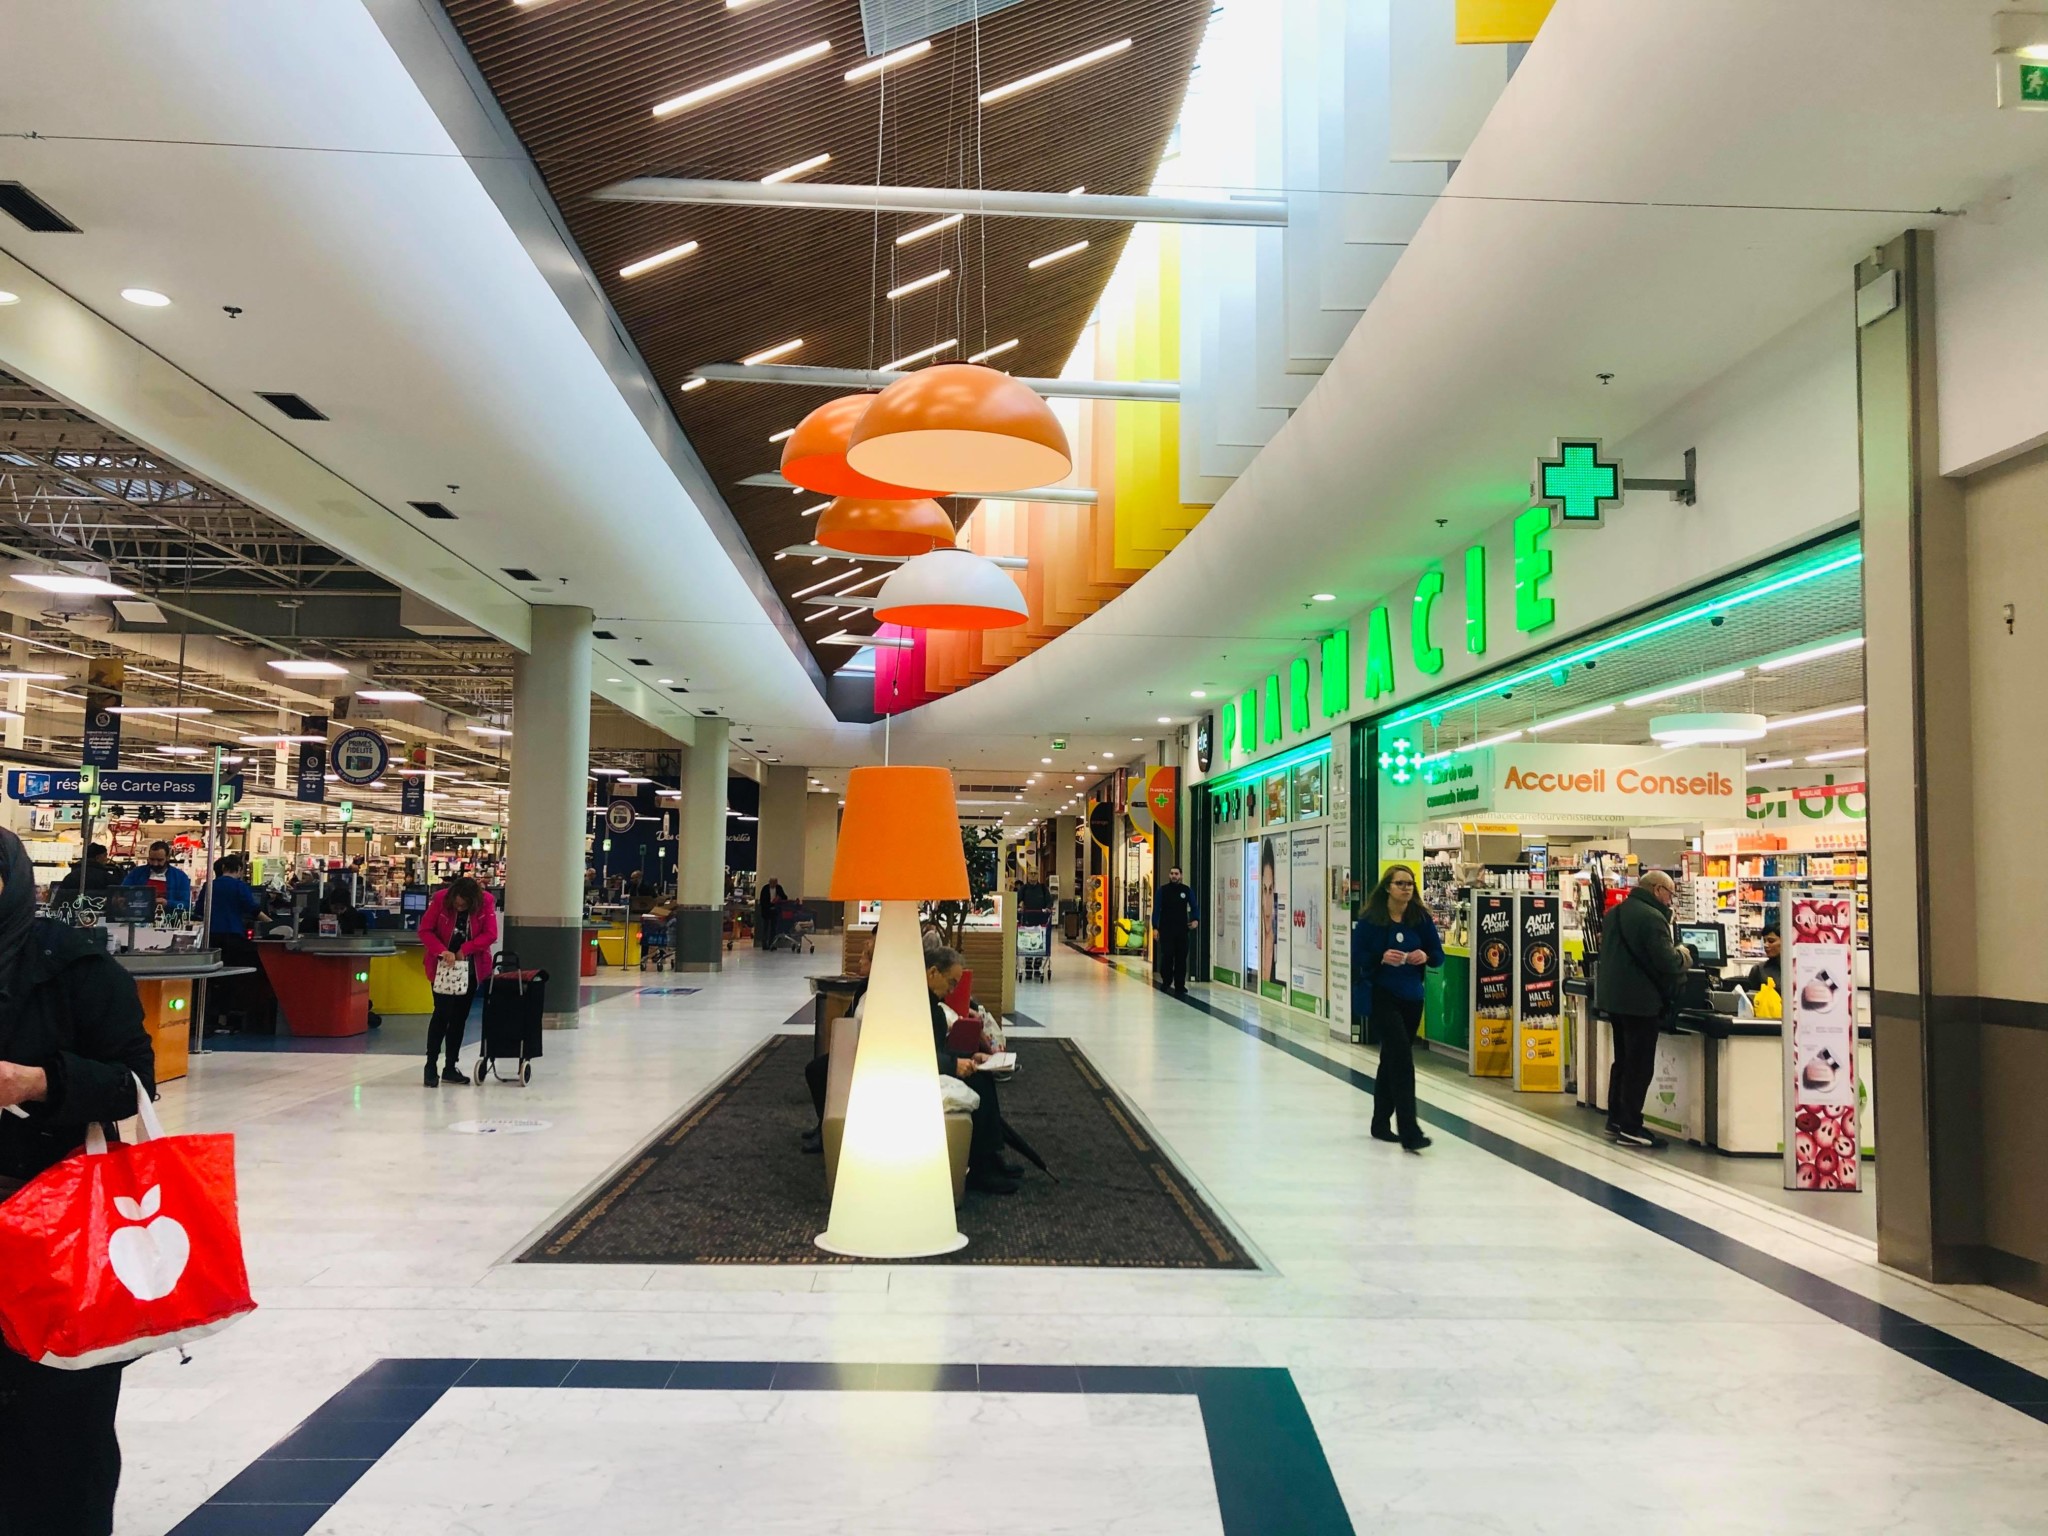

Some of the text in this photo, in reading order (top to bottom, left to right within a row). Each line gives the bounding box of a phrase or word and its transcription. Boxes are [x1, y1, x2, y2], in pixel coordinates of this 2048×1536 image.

[1222, 506, 1556, 768] PHARMACIE
[56, 778, 196, 793] résée Carte Pass
[1504, 766, 1734, 797] Accueil Conseils
[1481, 912, 1506, 926] ANTI
[1489, 920, 1510, 930] POUX
[1525, 913, 1551, 929] ANTI
[1533, 922, 1555, 933] POUX
[1484, 983, 1504, 993] HALTE
[1529, 991, 1551, 1001] HALTE
